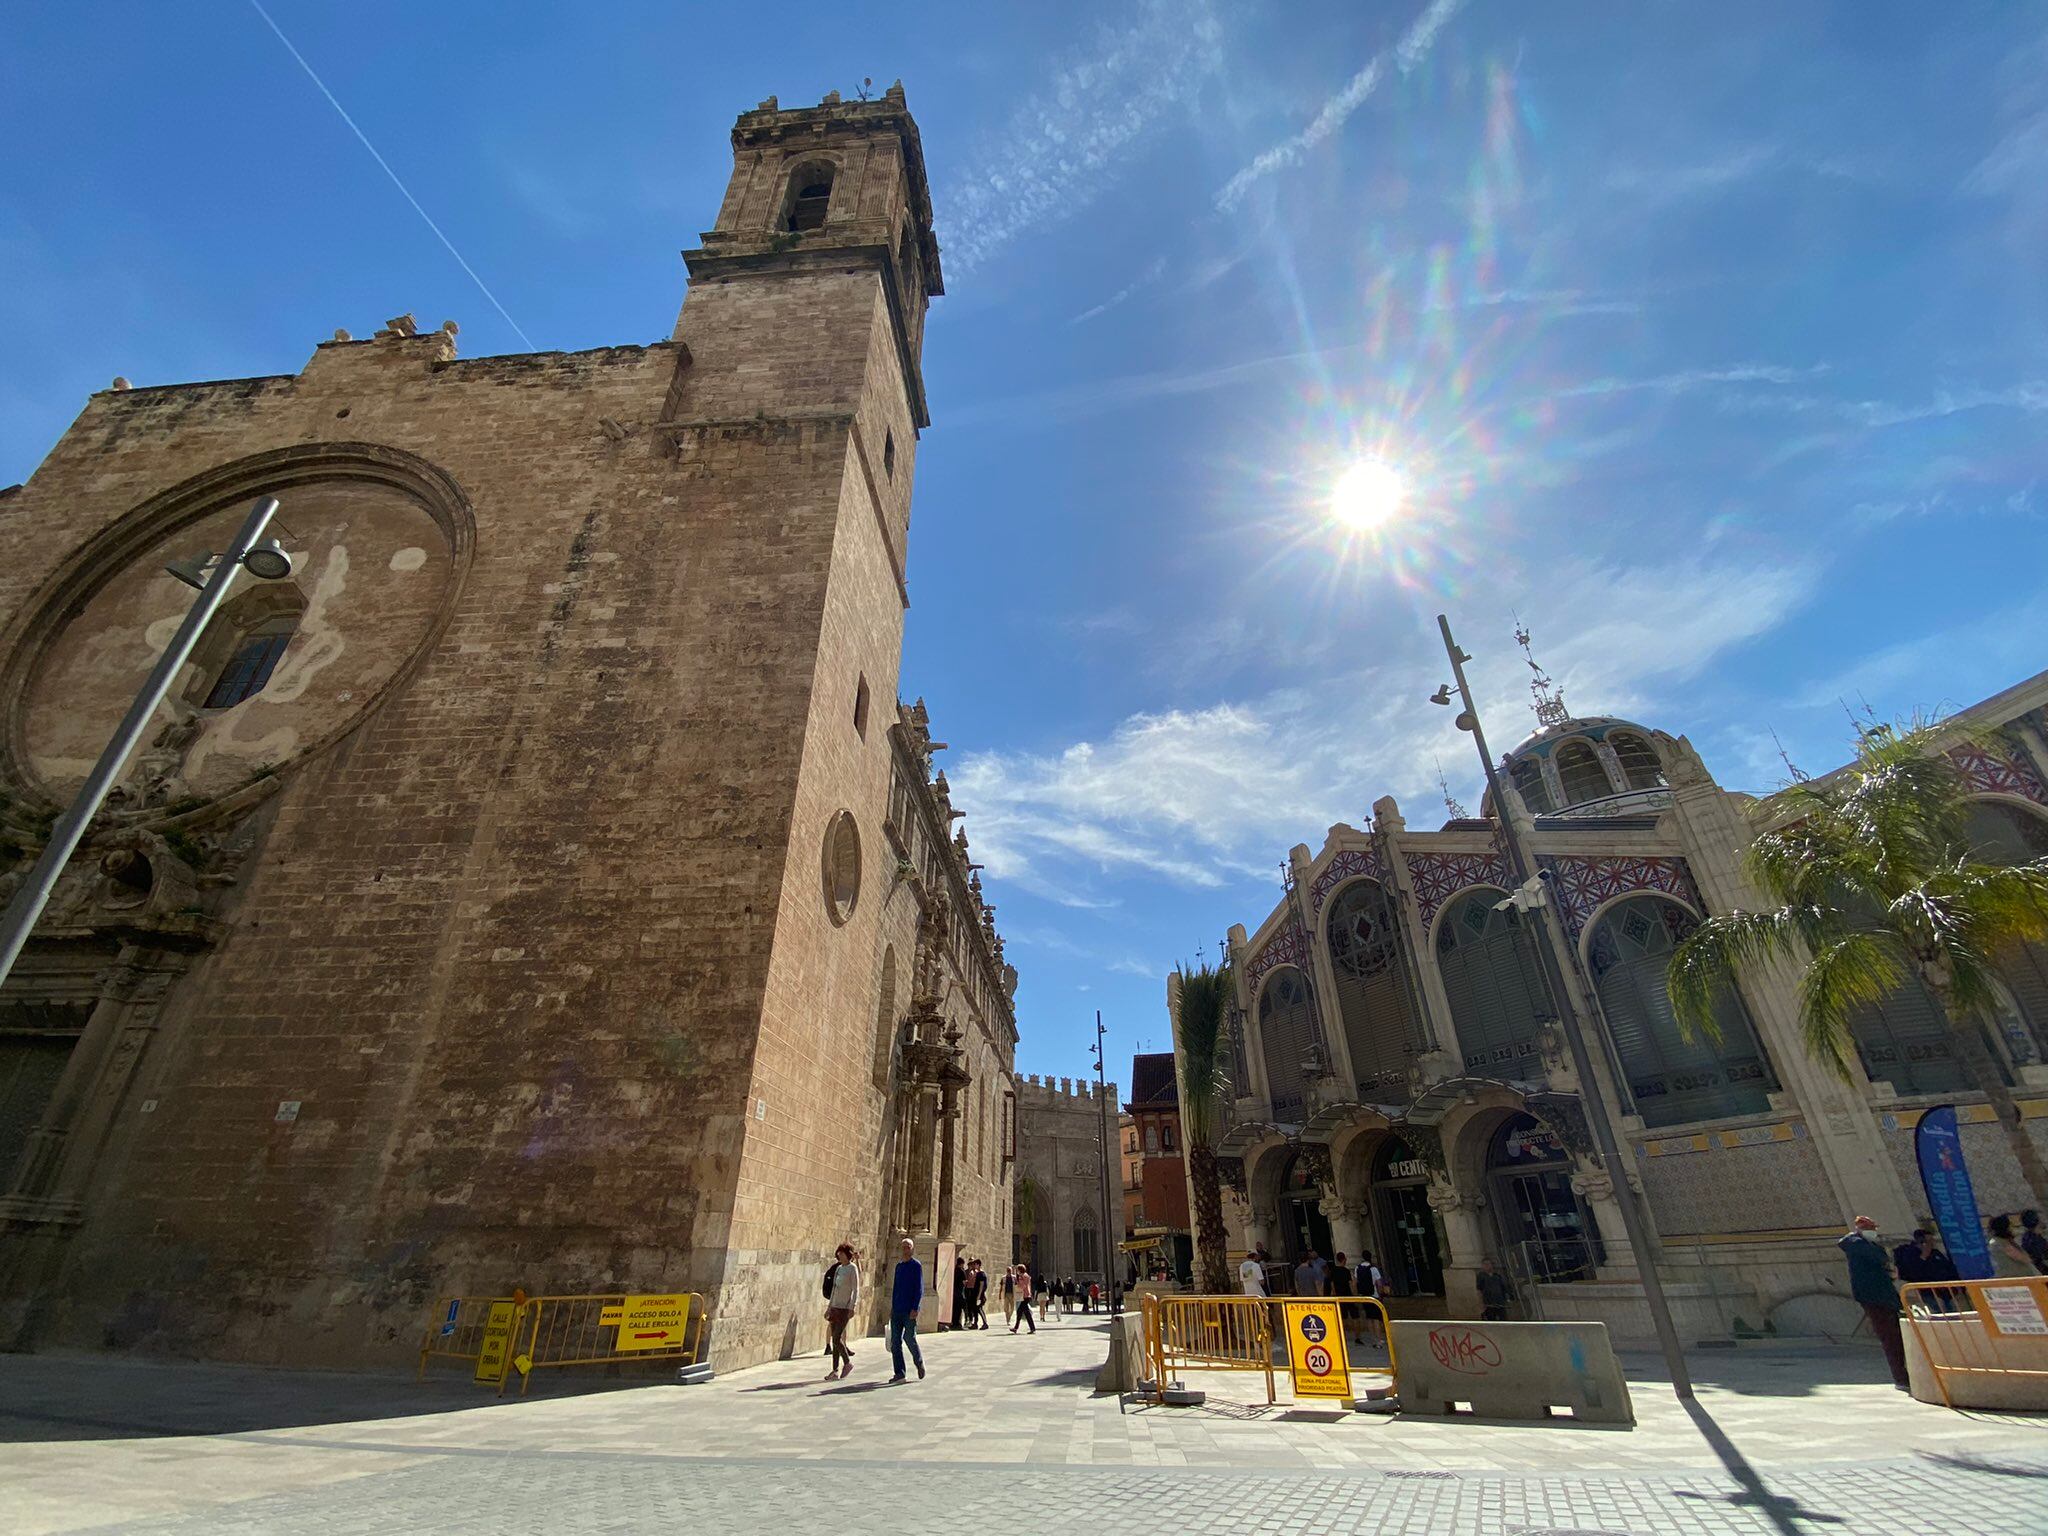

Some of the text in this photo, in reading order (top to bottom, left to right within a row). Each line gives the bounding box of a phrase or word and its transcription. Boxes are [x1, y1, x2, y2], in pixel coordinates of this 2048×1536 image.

[629, 1311, 657, 1319] ACCESO
[658, 1310, 677, 1318] SOLO
[628, 1320, 680, 1329] CALLE ERCILLA
[1310, 1355, 1327, 1368] 20
